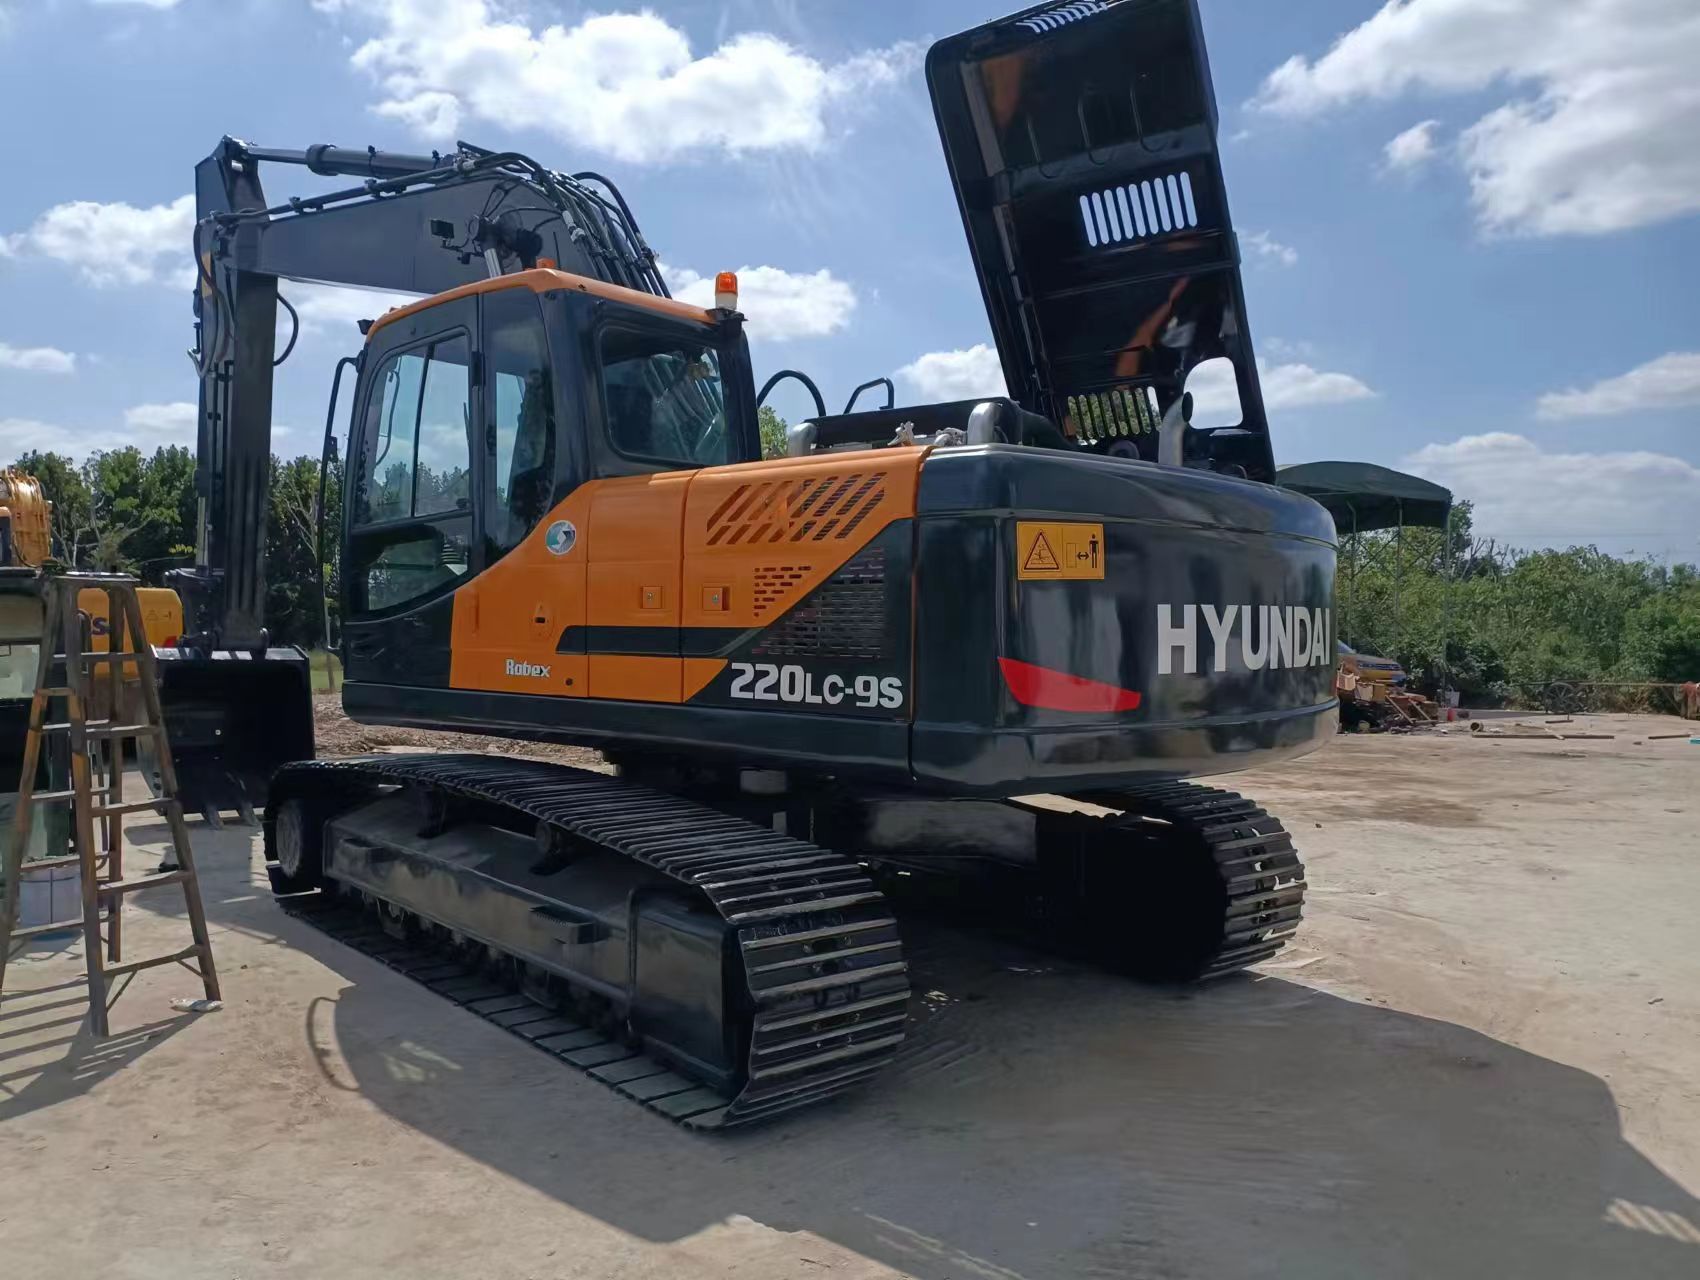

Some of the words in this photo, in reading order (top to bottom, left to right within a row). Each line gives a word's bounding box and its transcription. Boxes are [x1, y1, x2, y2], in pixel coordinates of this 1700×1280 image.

[1157, 603, 1330, 675] HYUNDAI
[505, 658, 551, 678] Robex
[730, 662, 904, 709] 220LC-9S
